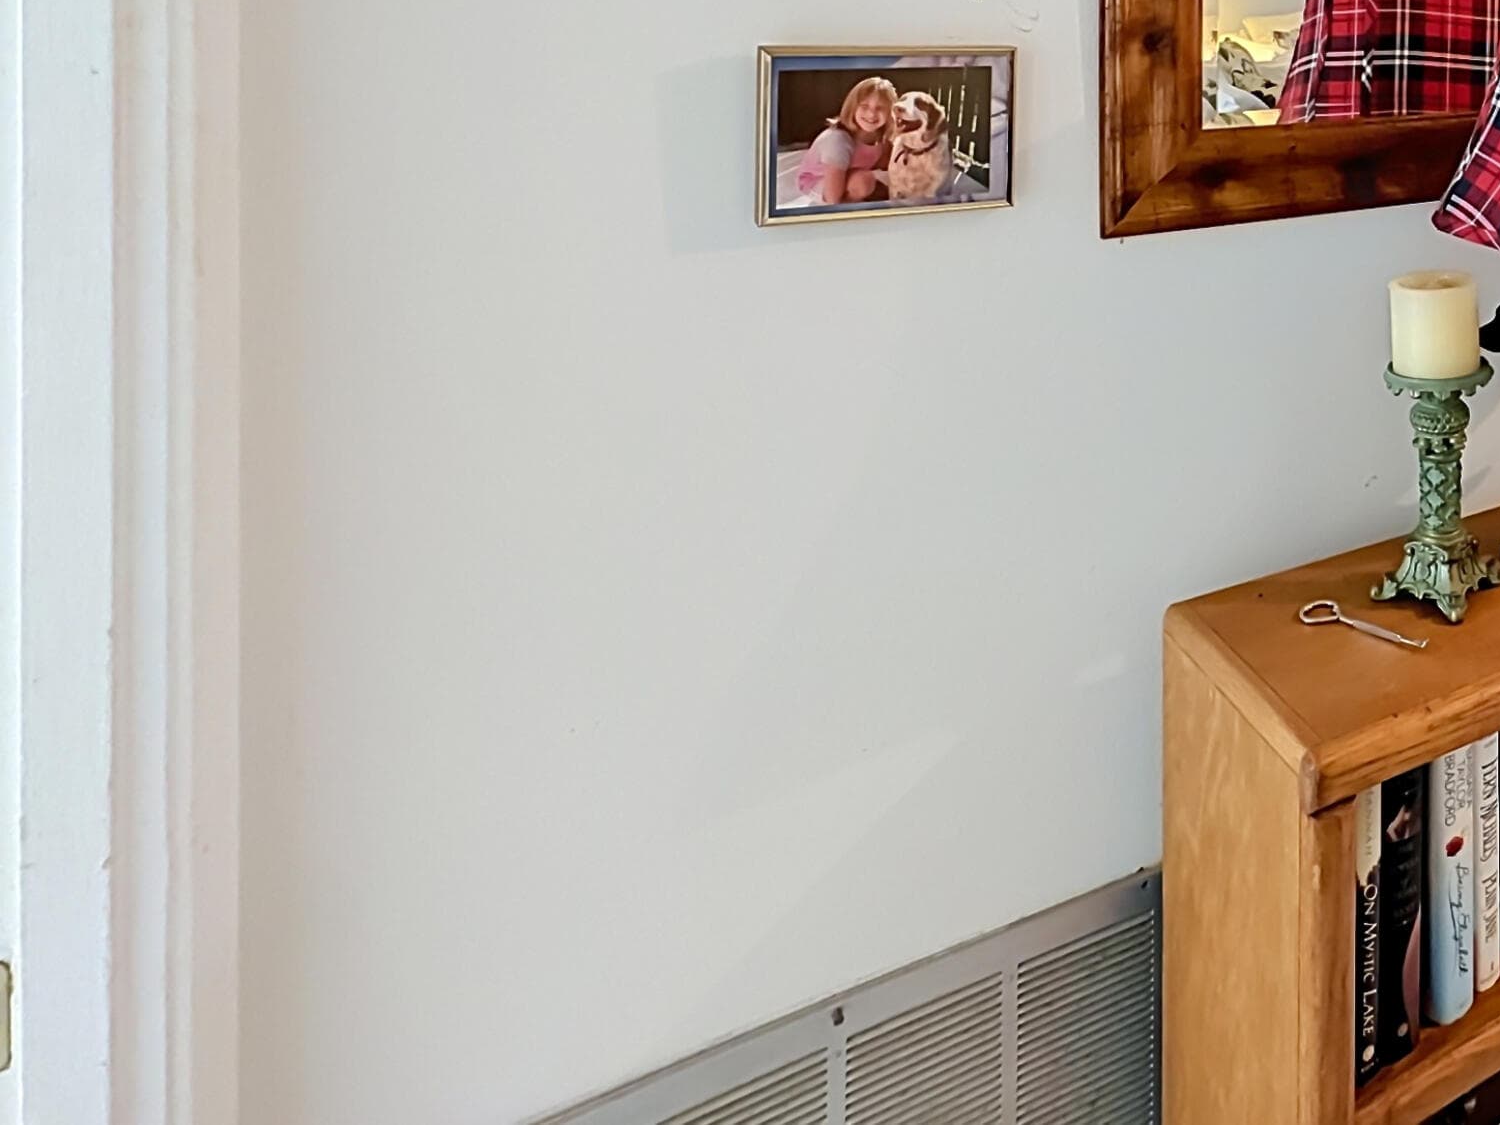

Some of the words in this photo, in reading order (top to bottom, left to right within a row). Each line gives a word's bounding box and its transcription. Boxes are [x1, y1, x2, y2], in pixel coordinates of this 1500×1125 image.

[1444, 754, 1456, 827] BRADFORD
[1456, 757, 1466, 811] TAYLOR
[1363, 883, 1378, 915] ON
[1482, 870, 1498, 912] PLAIN
[1362, 988, 1378, 1037] LAKE
